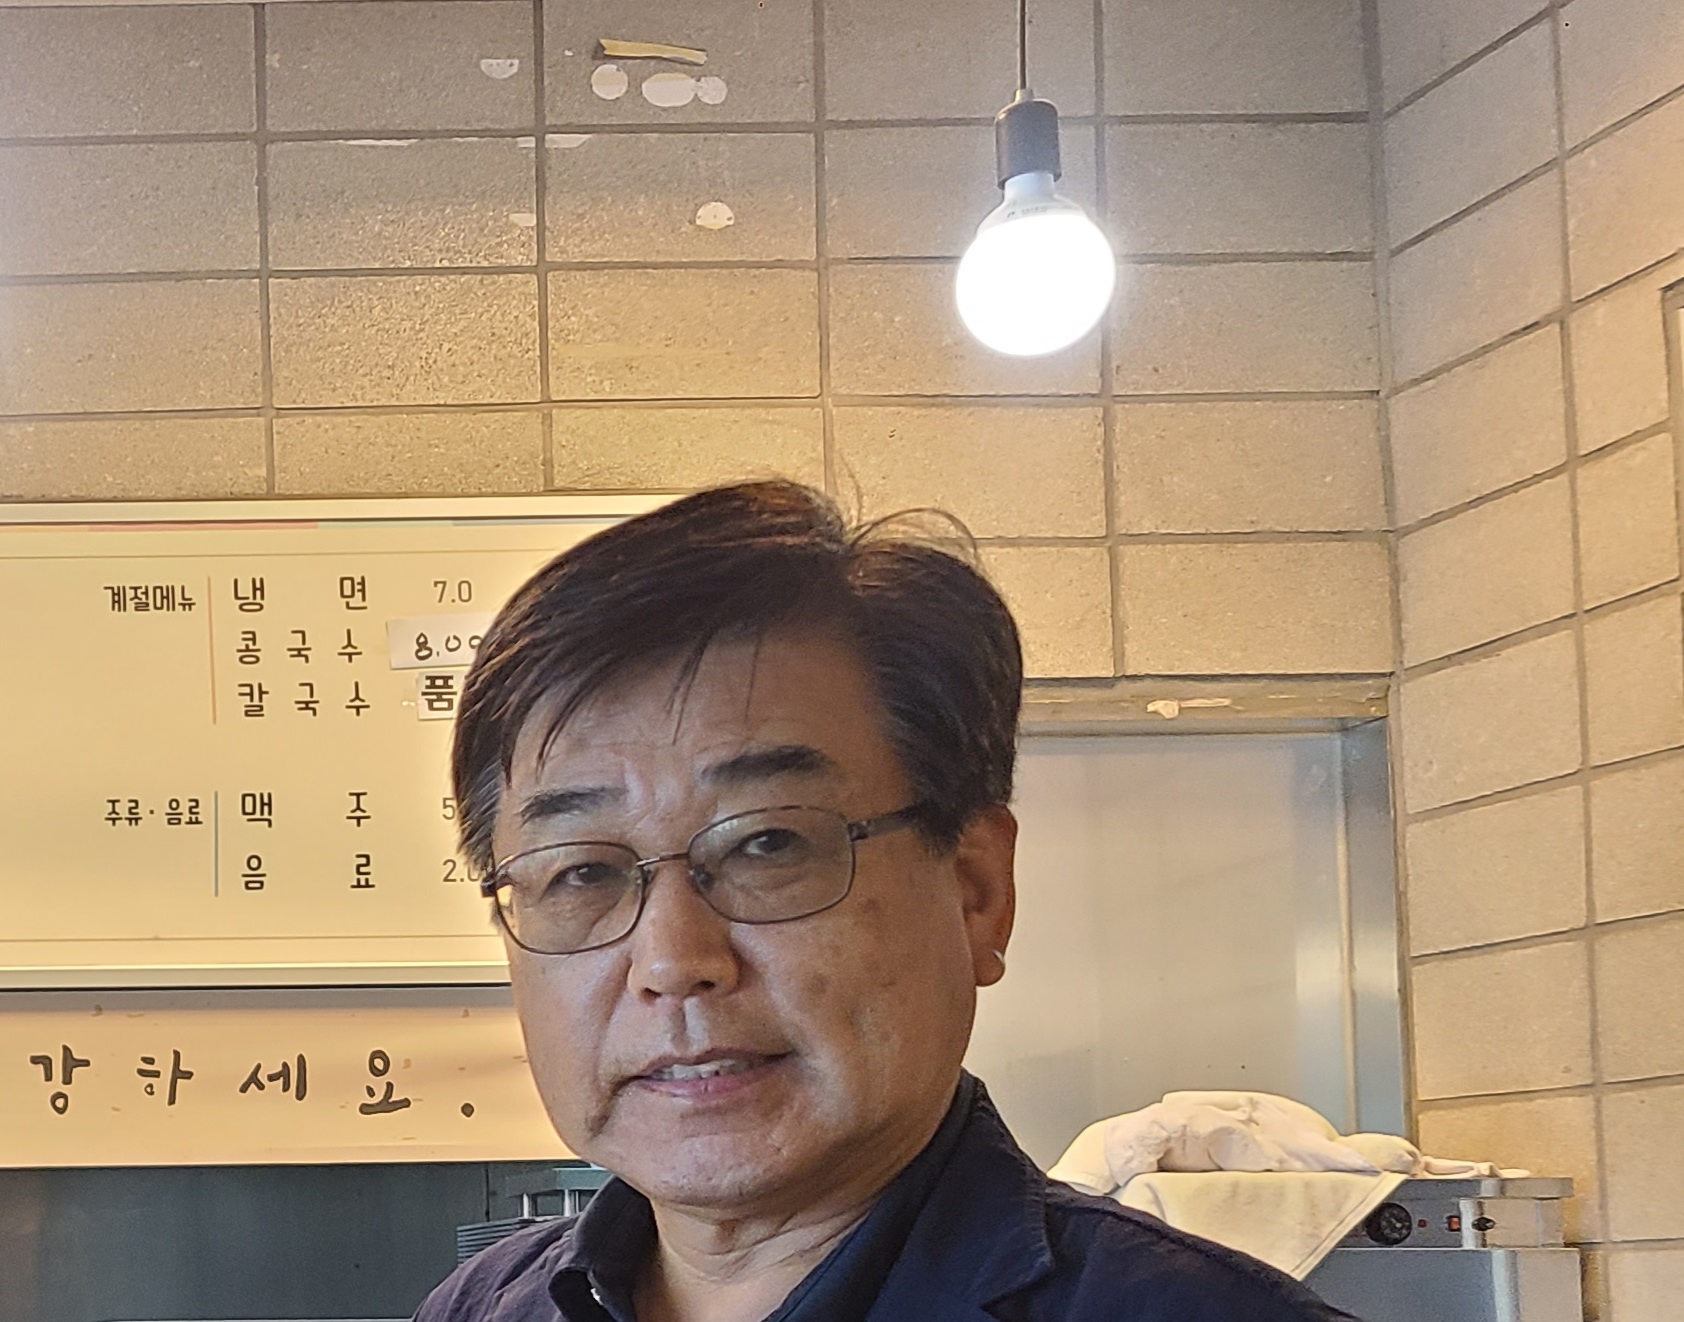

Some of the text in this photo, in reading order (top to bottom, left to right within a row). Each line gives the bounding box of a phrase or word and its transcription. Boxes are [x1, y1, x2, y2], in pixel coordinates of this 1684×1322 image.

[102, 583, 197, 614] 계절메뉴
[432, 579, 473, 605] 7.0
[420, 674, 458, 712] 품
